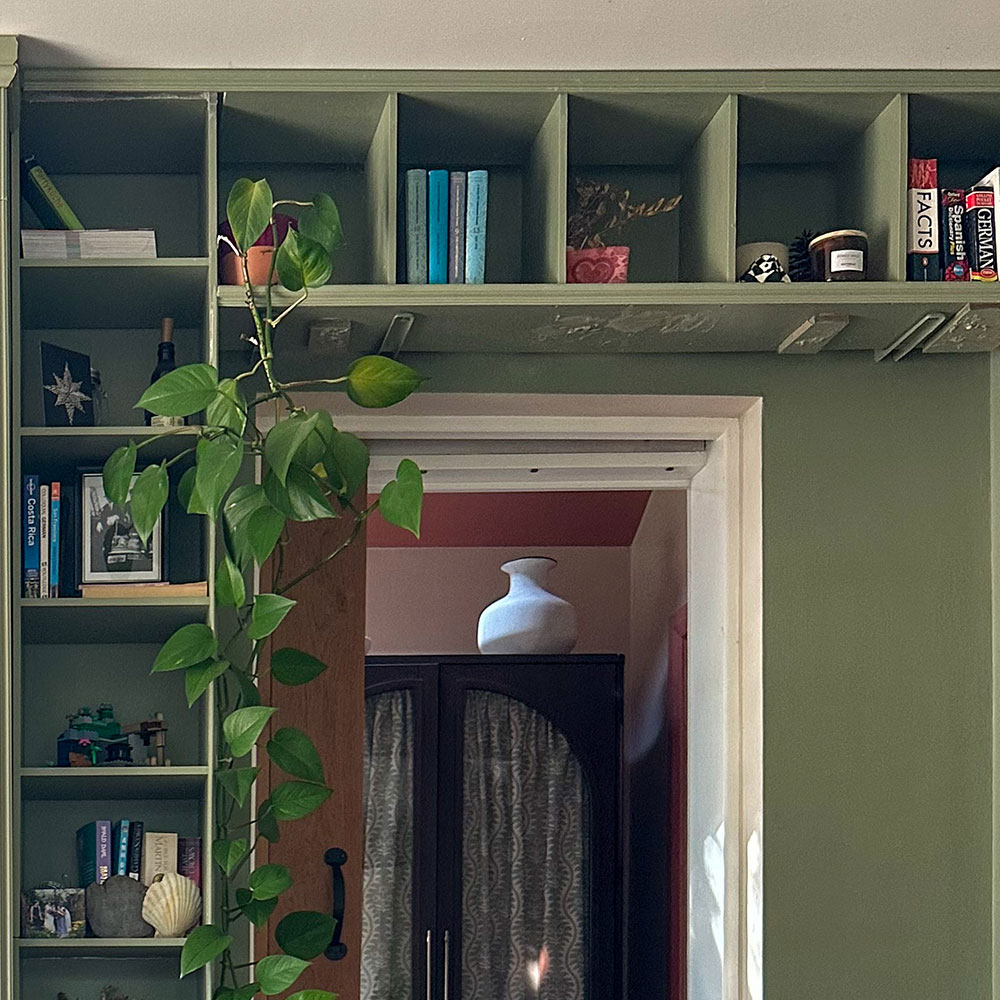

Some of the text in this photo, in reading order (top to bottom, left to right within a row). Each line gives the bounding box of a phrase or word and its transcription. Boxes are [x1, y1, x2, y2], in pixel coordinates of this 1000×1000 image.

[917, 192, 932, 248] FACTS
[954, 205, 966, 260] Spanish
[978, 209, 994, 269] GERMAN
[27, 498, 36, 546] Costa Rica
